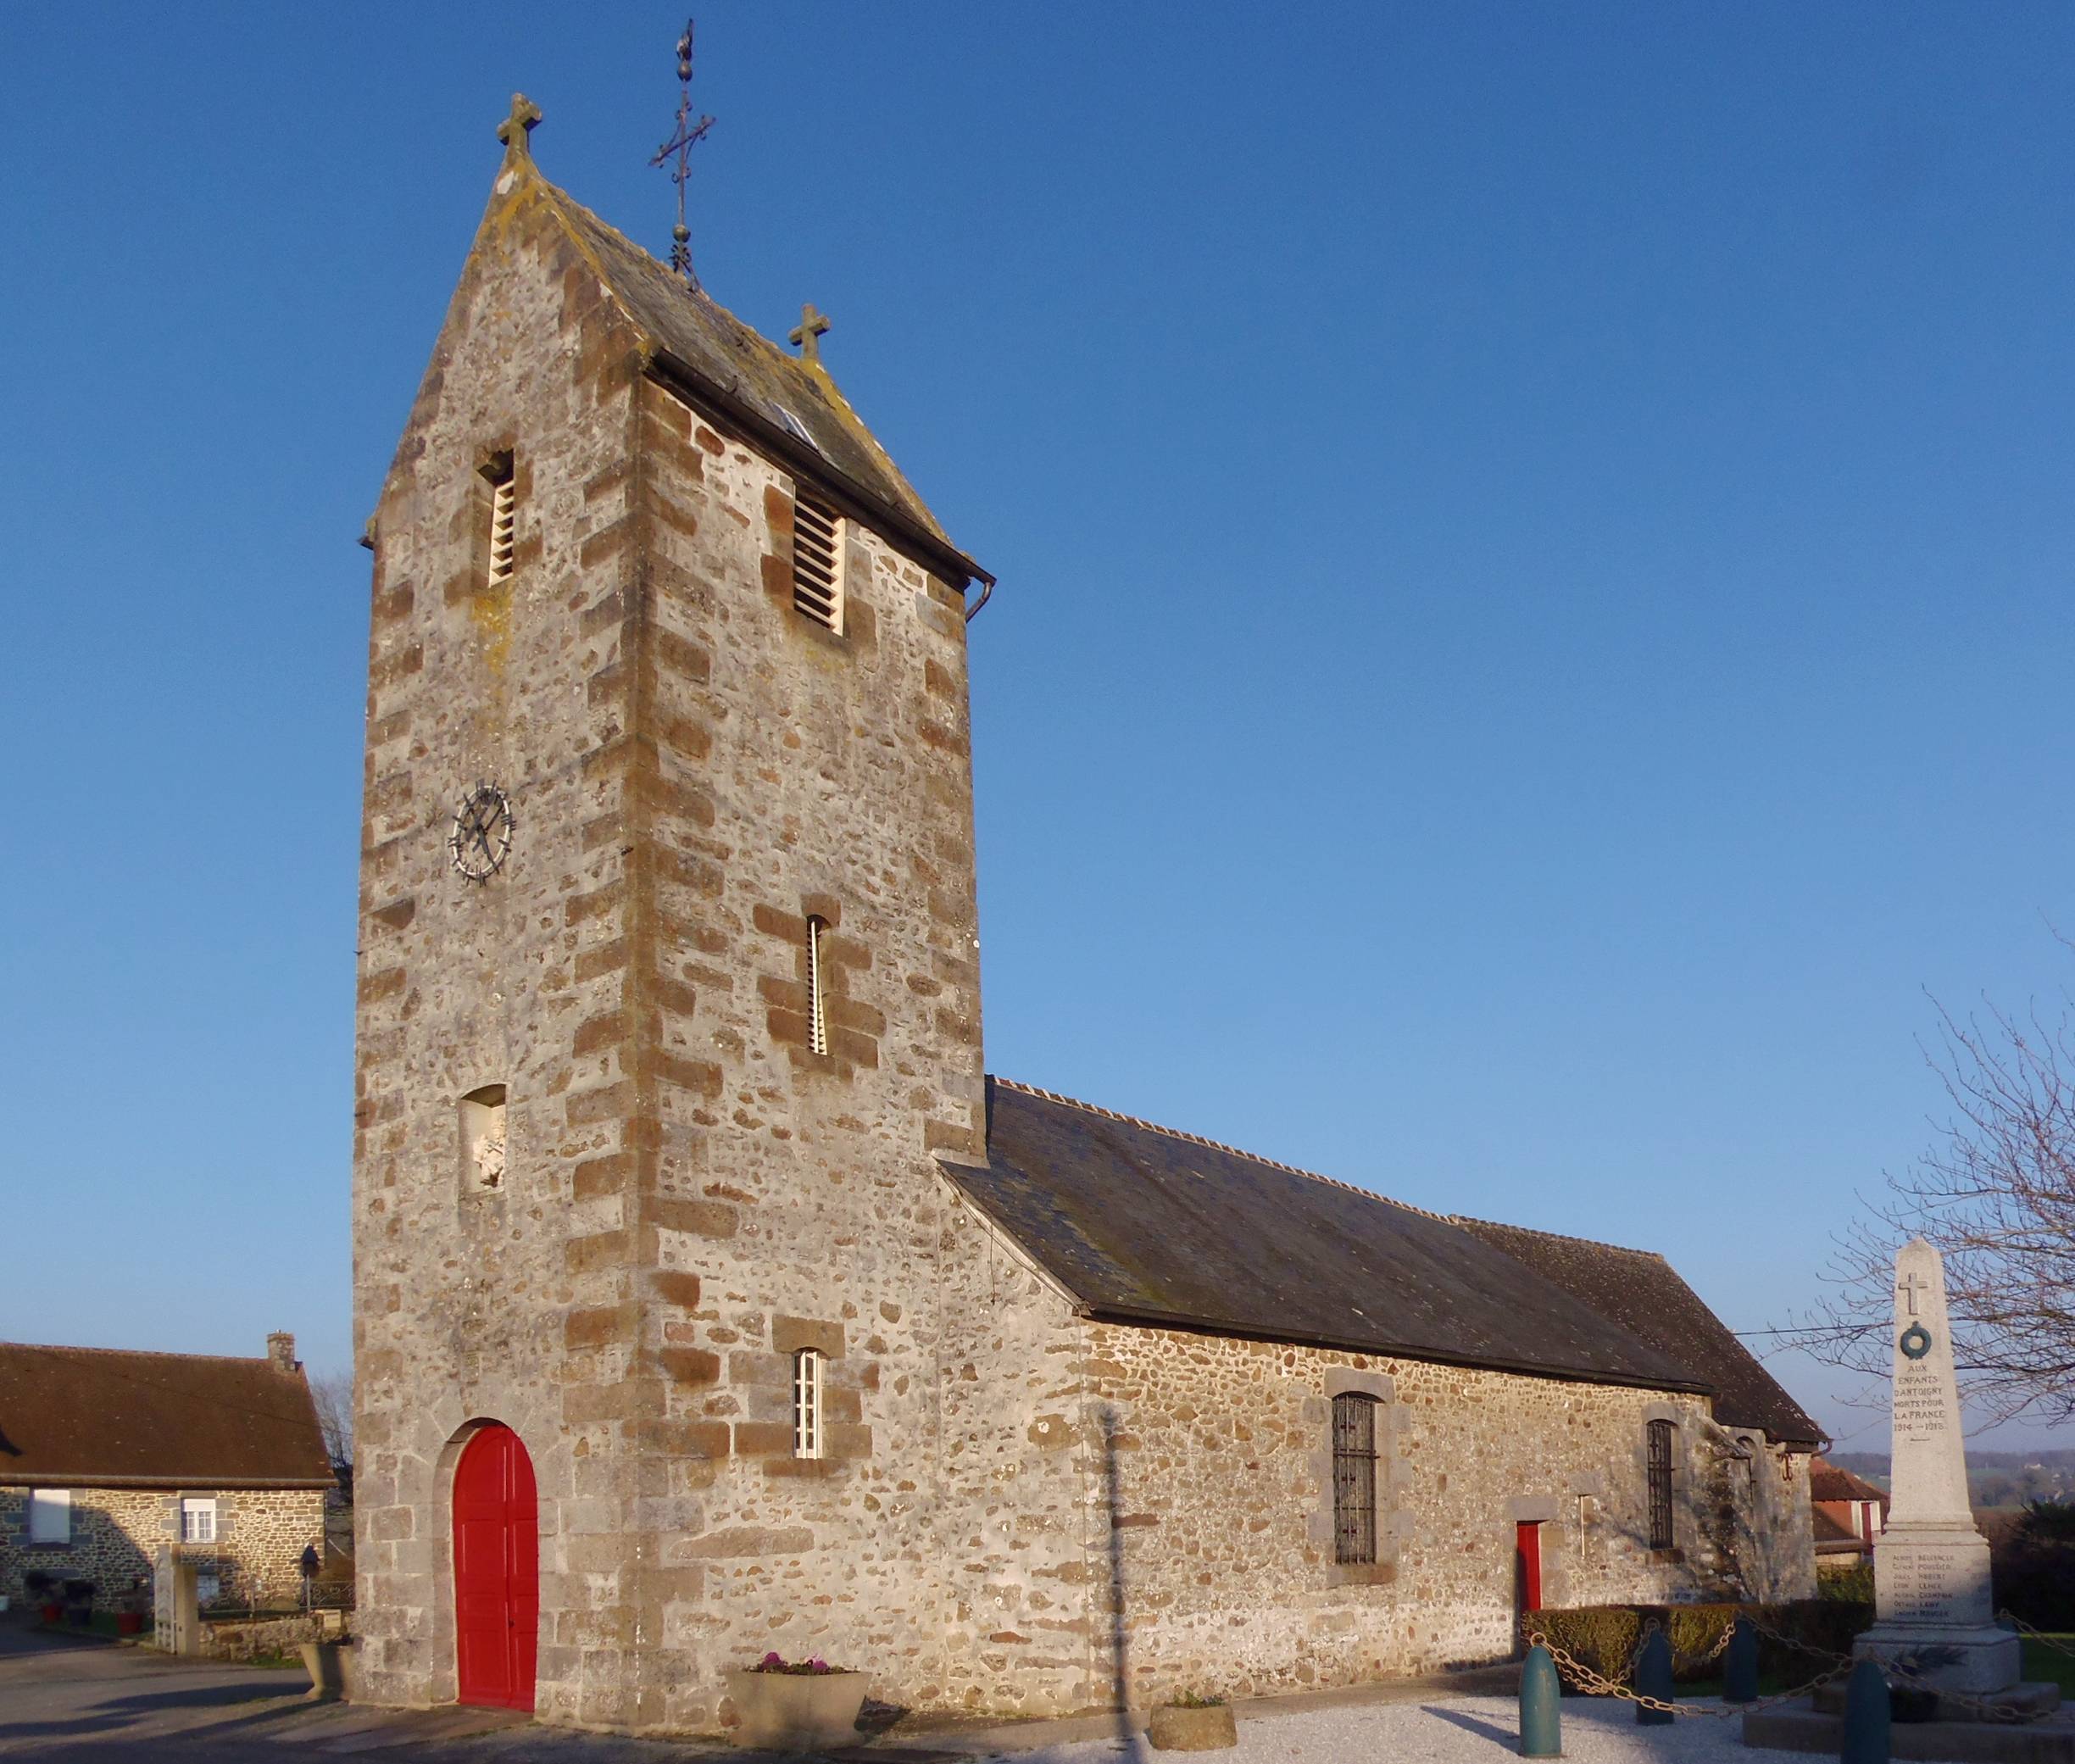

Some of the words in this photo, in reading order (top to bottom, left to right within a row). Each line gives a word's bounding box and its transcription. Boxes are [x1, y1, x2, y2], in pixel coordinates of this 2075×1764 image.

[1907, 1365, 1928, 1373] AUX
[1898, 1376, 1939, 1385] ENFANTS
[1894, 1400, 1920, 1408] MORTS
[1909, 1410, 1945, 1420] FRANCE
[1894, 1423, 1912, 1433] 1914
